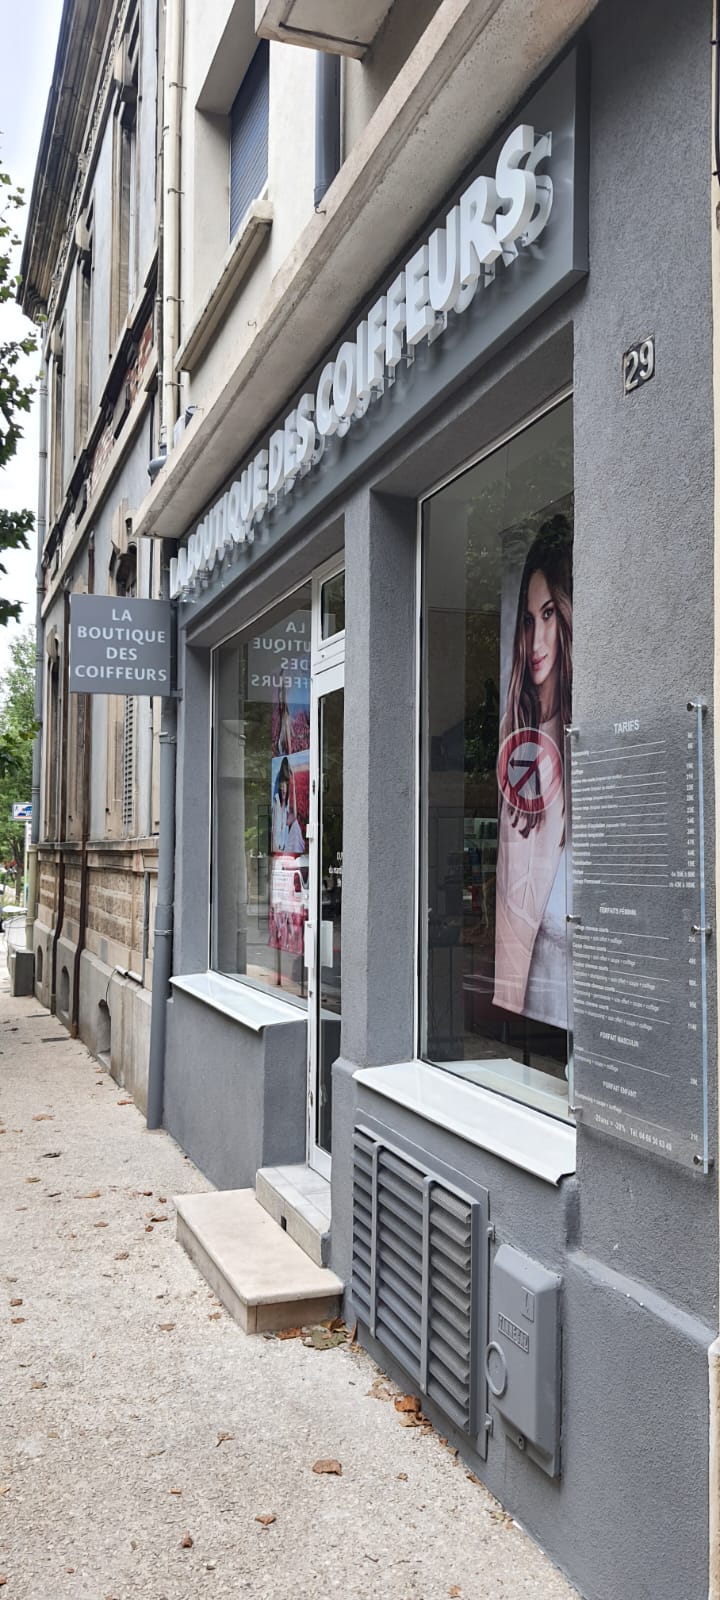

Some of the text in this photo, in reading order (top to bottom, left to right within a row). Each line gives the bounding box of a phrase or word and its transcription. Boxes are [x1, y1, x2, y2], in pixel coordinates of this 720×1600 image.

[268, 393, 320, 496] DES
[316, 123, 548, 437] COIFFEURS
[625, 340, 654, 391] 29
[111, 608, 133, 622] LA
[77, 625, 166, 645] BOUTIQUE
[106, 647, 138, 661] DES
[74, 665, 167, 682] COIFFEURS
[613, 719, 640, 735] TARIFS
